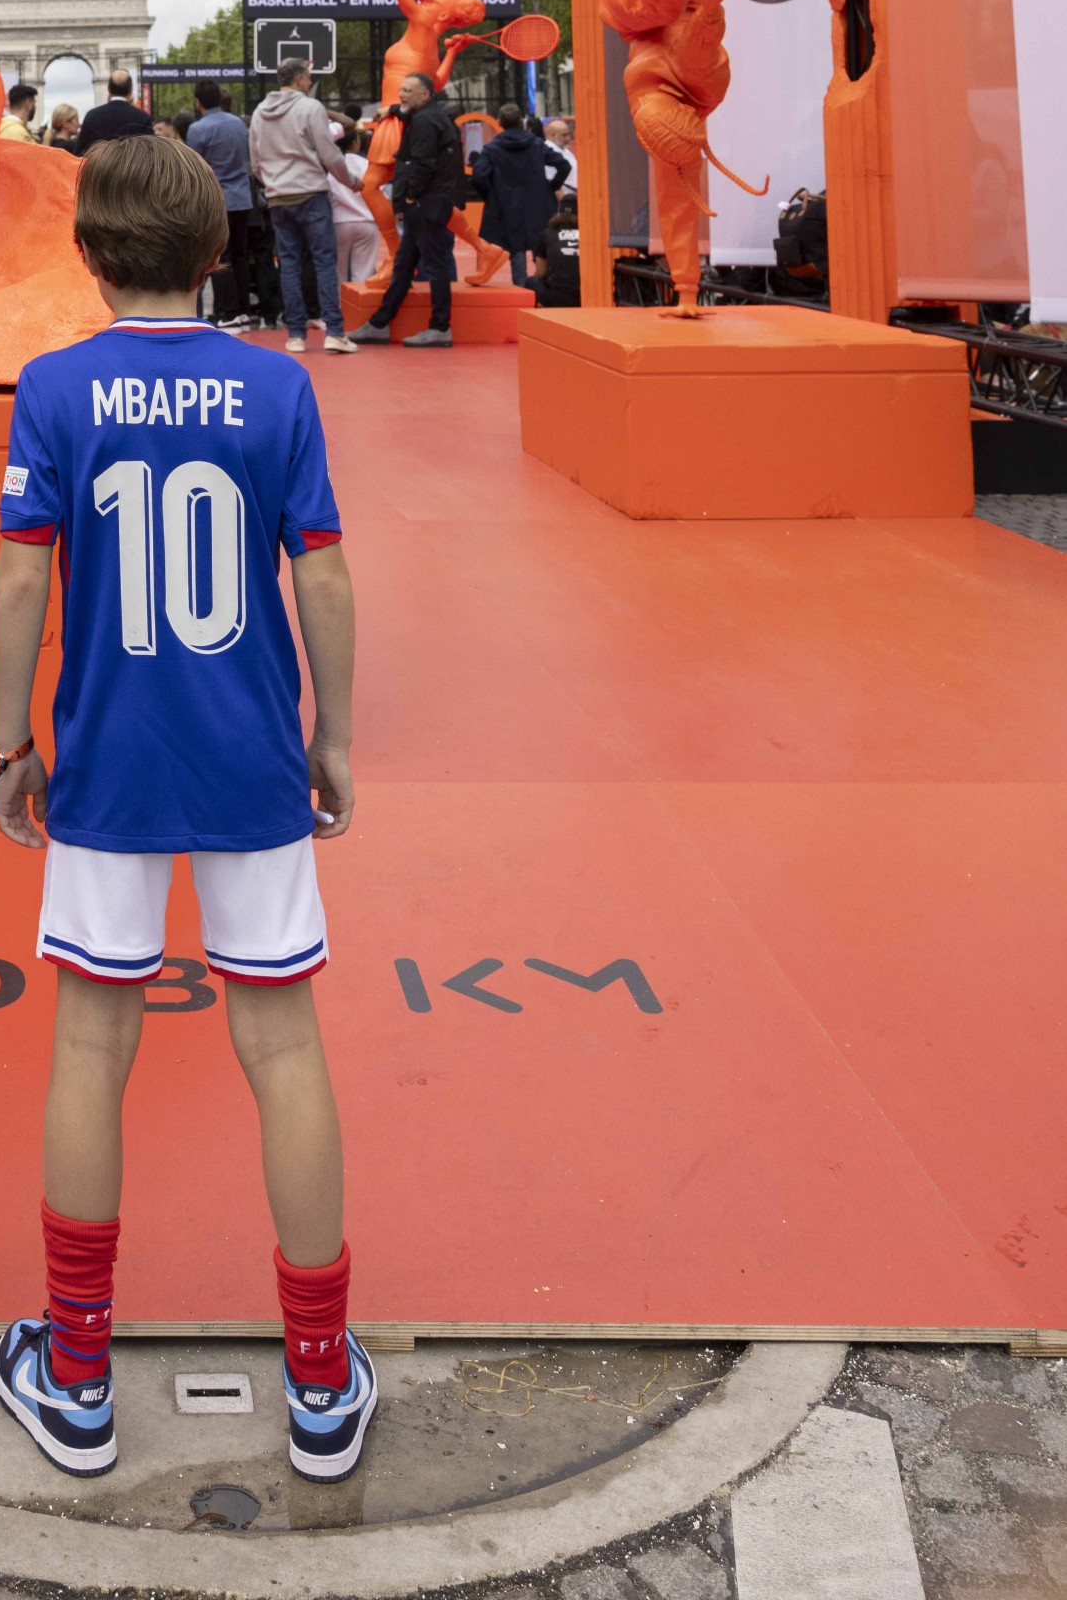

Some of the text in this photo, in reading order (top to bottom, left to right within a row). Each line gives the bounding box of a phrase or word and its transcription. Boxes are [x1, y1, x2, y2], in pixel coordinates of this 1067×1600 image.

[142, 69, 179, 77] RUNNING
[185, 69, 196, 77] EN
[198, 69, 221, 77] MODE
[92, 377, 244, 427] MBAPPE
[93, 460, 247, 656] 10
[393, 957, 663, 1014] KM
[79, 1385, 105, 1404] NIKE
[303, 1390, 331, 1406] NIKE
